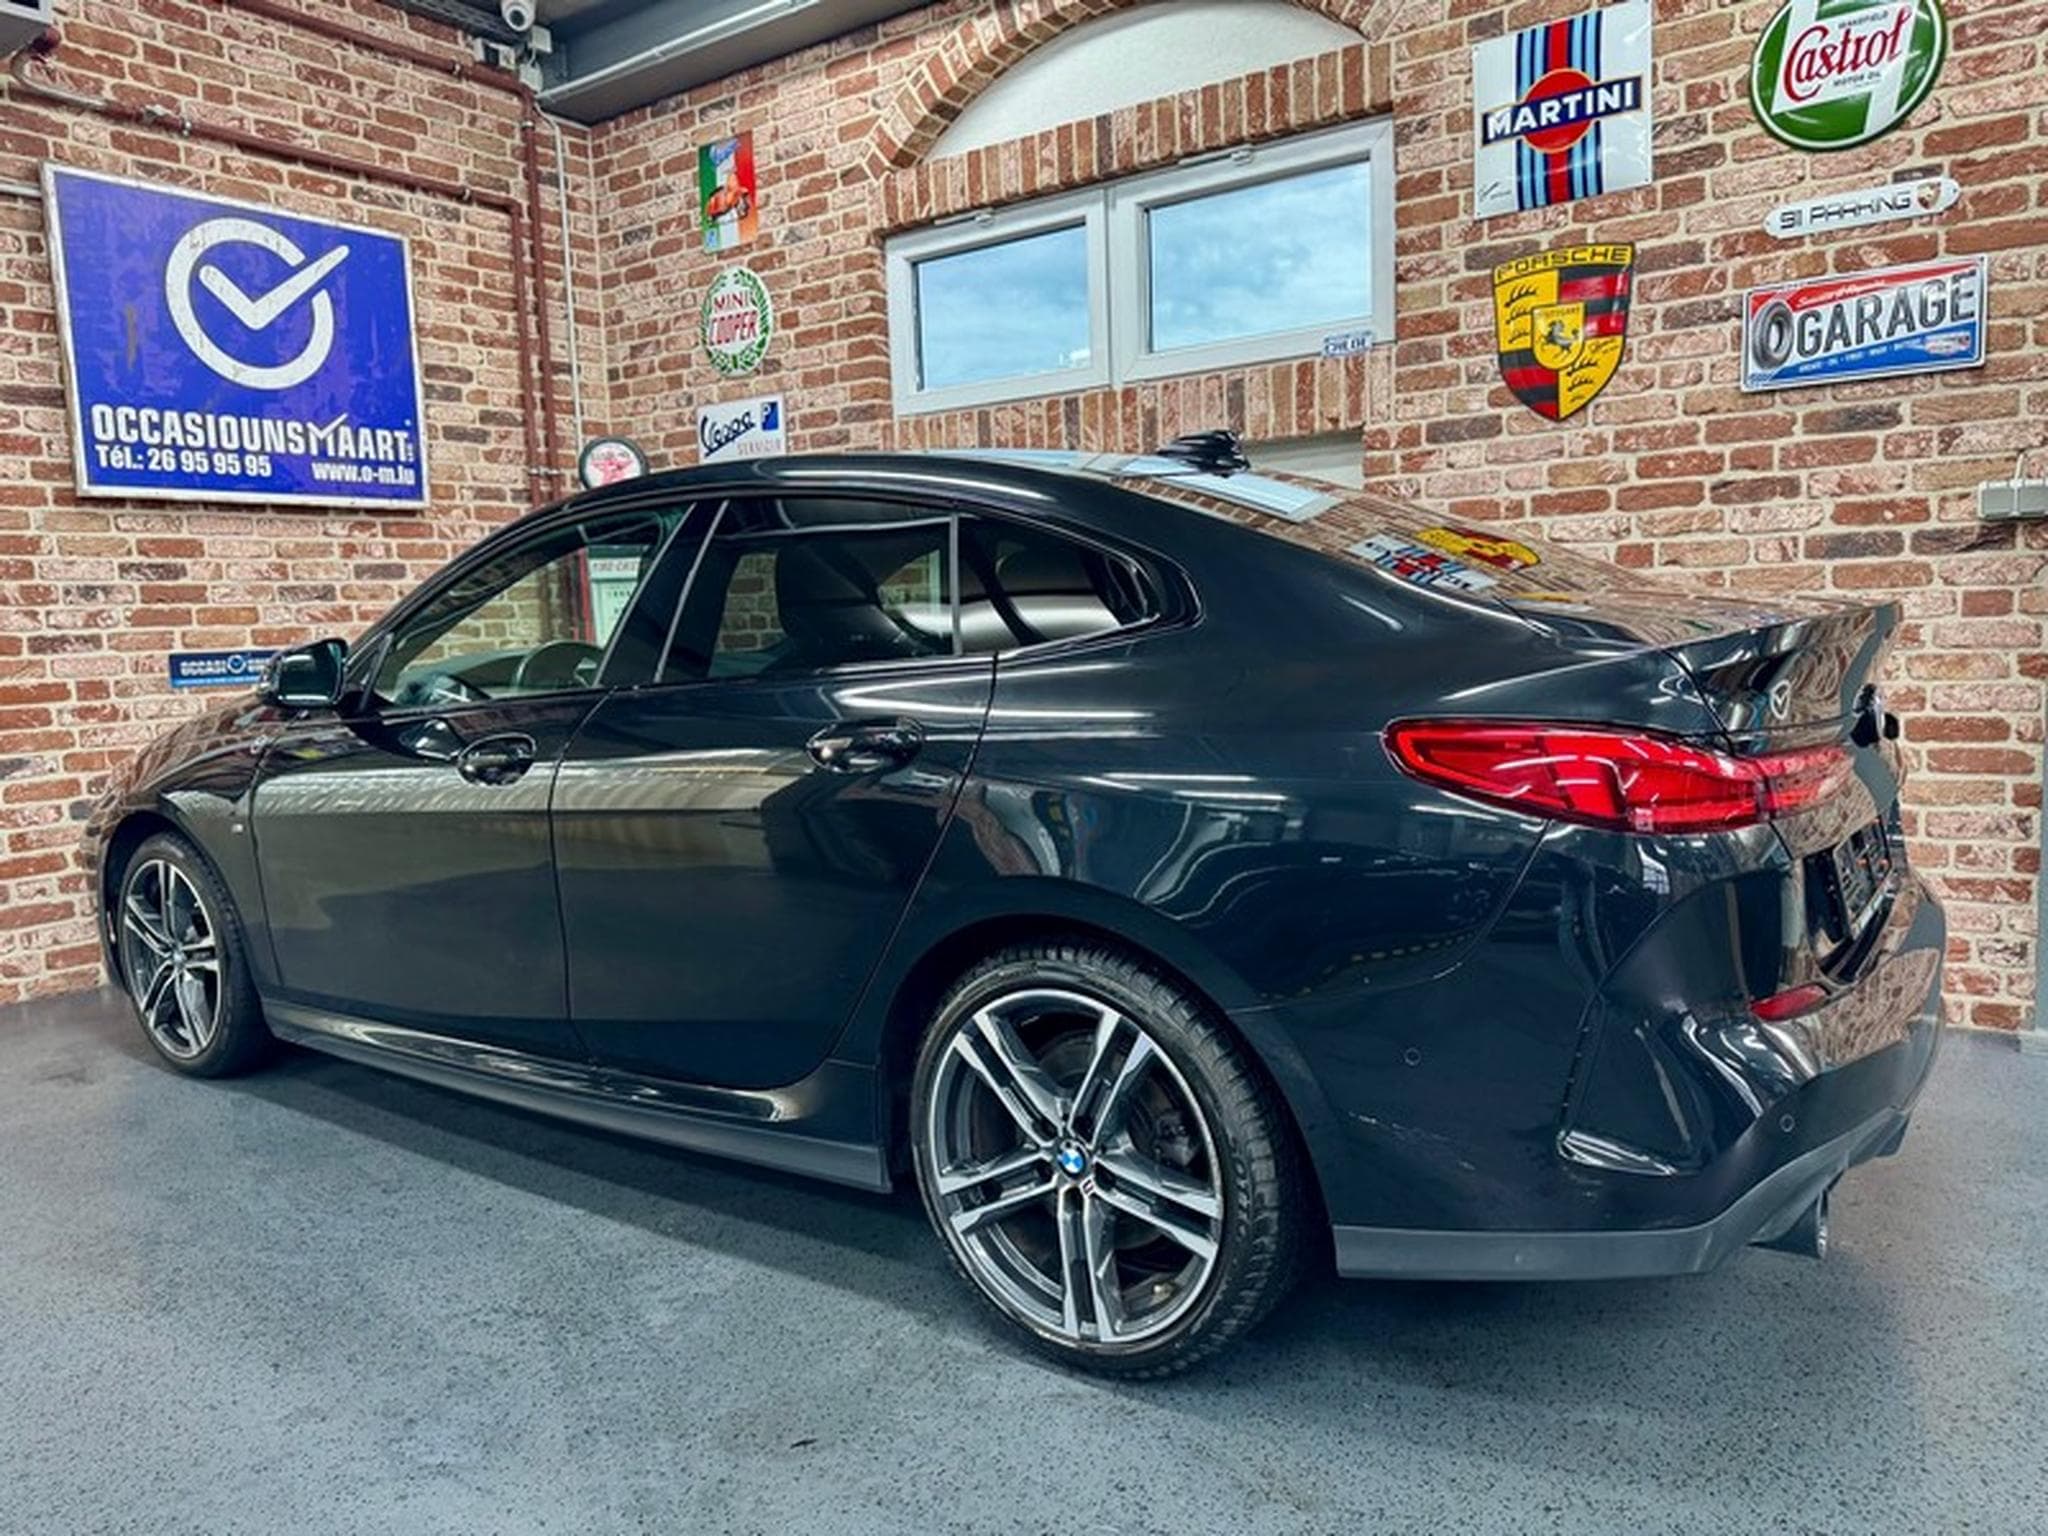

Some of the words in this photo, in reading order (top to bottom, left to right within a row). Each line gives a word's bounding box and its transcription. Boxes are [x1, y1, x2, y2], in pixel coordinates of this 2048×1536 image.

[1784, 5, 1911, 104] Castrol
[1487, 82, 1634, 139] MARTINI
[1497, 247, 1629, 280] PORSCHE
[714, 289, 750, 314] MINI
[1797, 269, 1978, 358] GARAGE
[709, 310, 757, 347] COOPER
[700, 411, 756, 457] Vespa
[95, 445, 144, 470] Tél.:
[147, 447, 176, 472] 26
[181, 451, 209, 475] 95
[213, 452, 241, 477] 95
[245, 454, 272, 478] 95
[312, 461, 416, 486] www.o-m.lu
